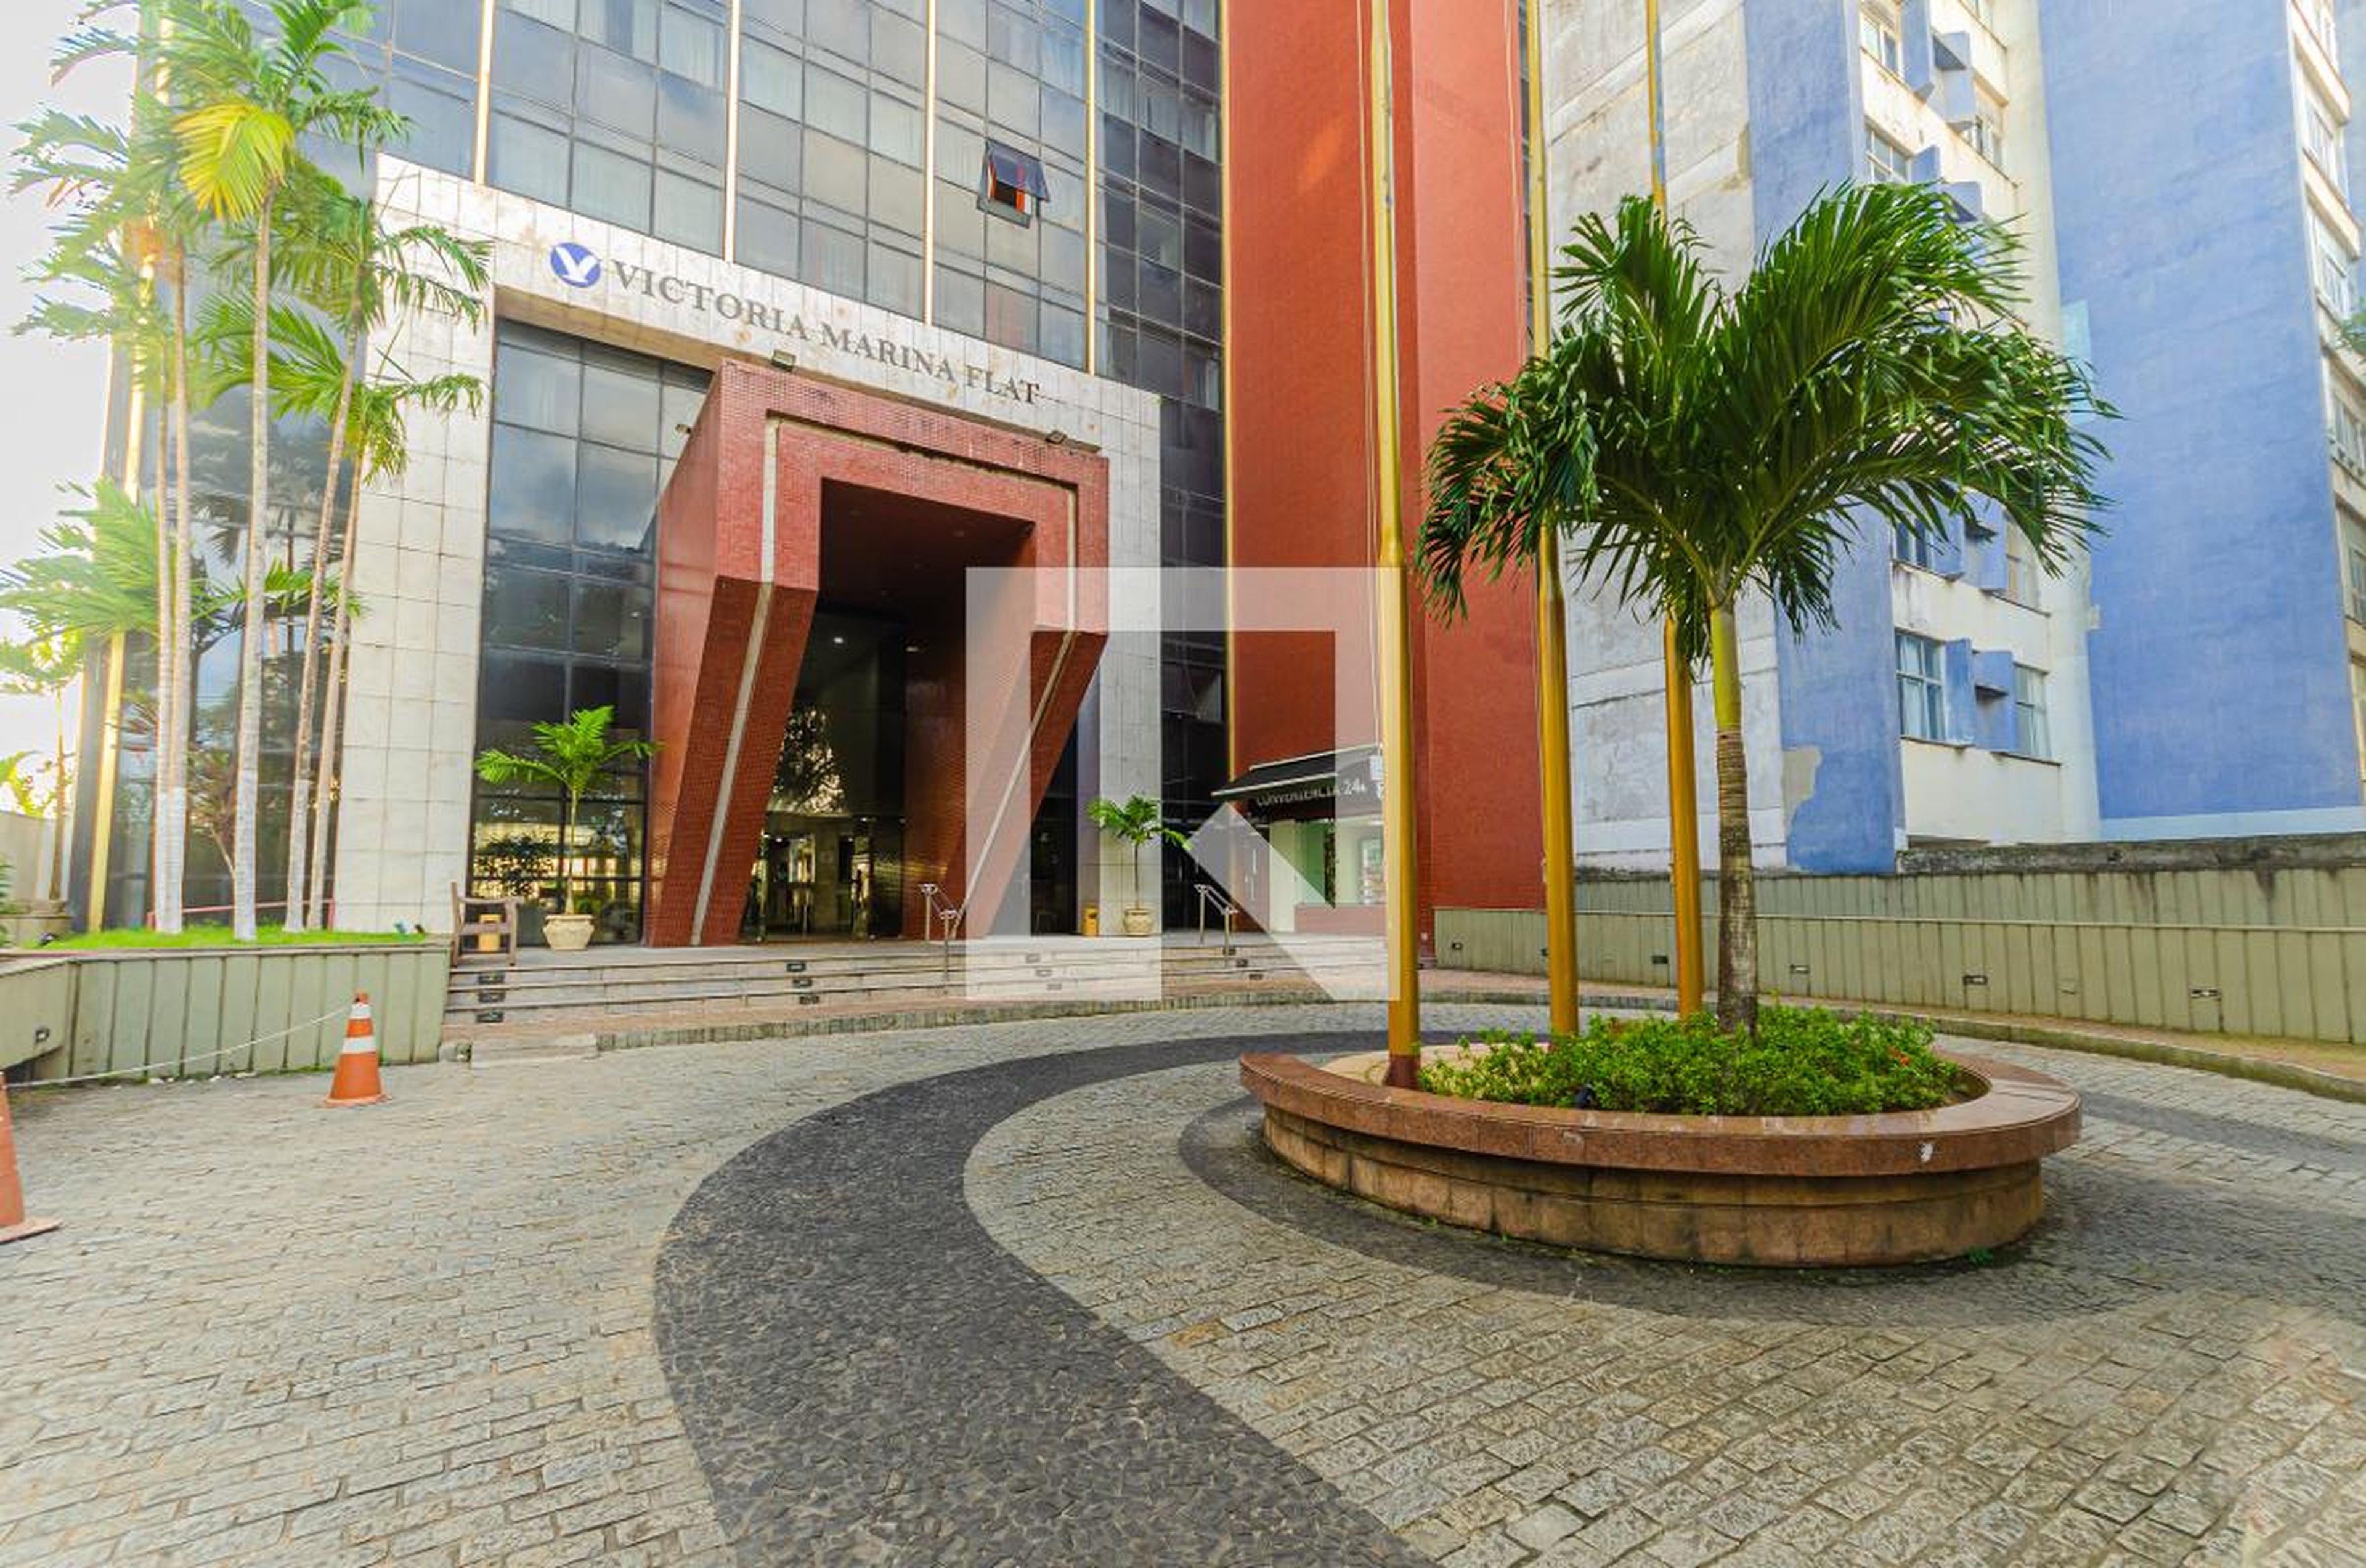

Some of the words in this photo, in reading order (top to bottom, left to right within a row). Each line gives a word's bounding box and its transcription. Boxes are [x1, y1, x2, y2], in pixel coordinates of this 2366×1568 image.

[612, 258, 807, 340] VICTORIA
[820, 322, 955, 383] MARINA
[964, 364, 1039, 404] FLAT
